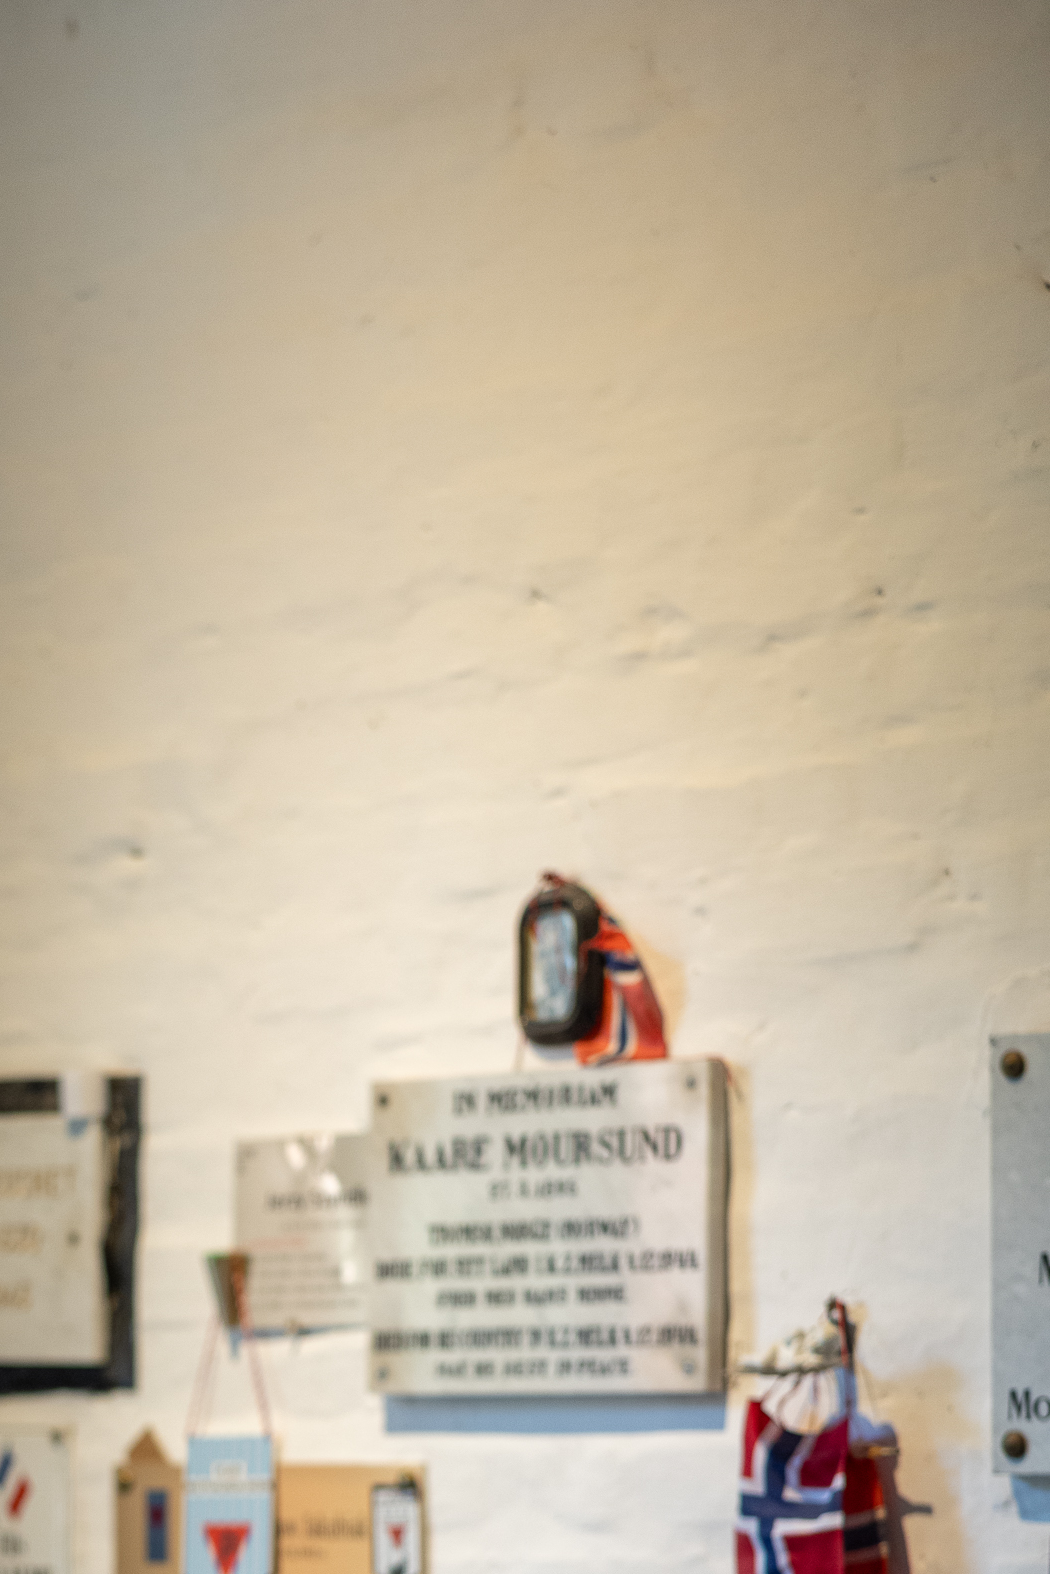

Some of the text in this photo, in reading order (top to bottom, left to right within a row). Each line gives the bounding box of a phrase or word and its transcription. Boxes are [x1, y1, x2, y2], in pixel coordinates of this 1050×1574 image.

[453, 1081, 619, 1115] IN MEMORIAM
[388, 1124, 684, 1173] KAARE MOURSUND
